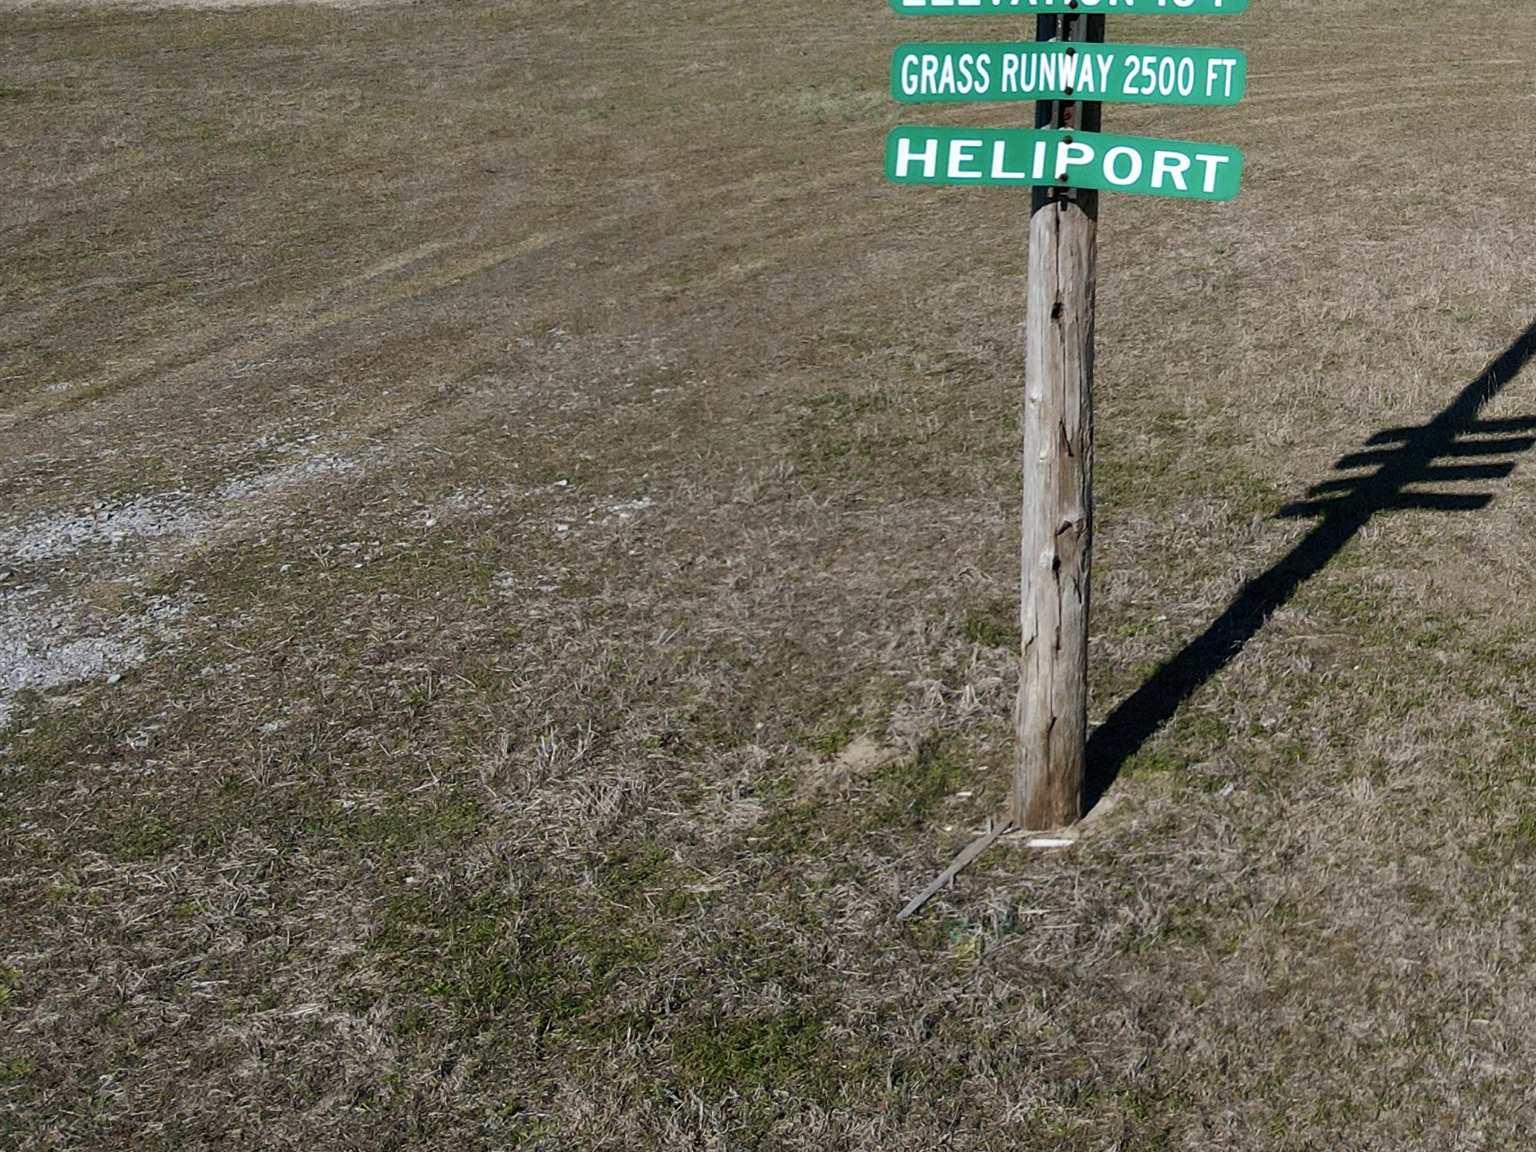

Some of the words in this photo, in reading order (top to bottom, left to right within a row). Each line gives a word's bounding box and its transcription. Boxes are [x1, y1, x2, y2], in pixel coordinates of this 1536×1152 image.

[901, 53, 991, 95] GRASS
[1000, 52, 1114, 94] RUNWAY
[1122, 55, 1194, 96] 2500
[1205, 58, 1237, 97] FT
[895, 137, 1229, 193] HELIPORT
